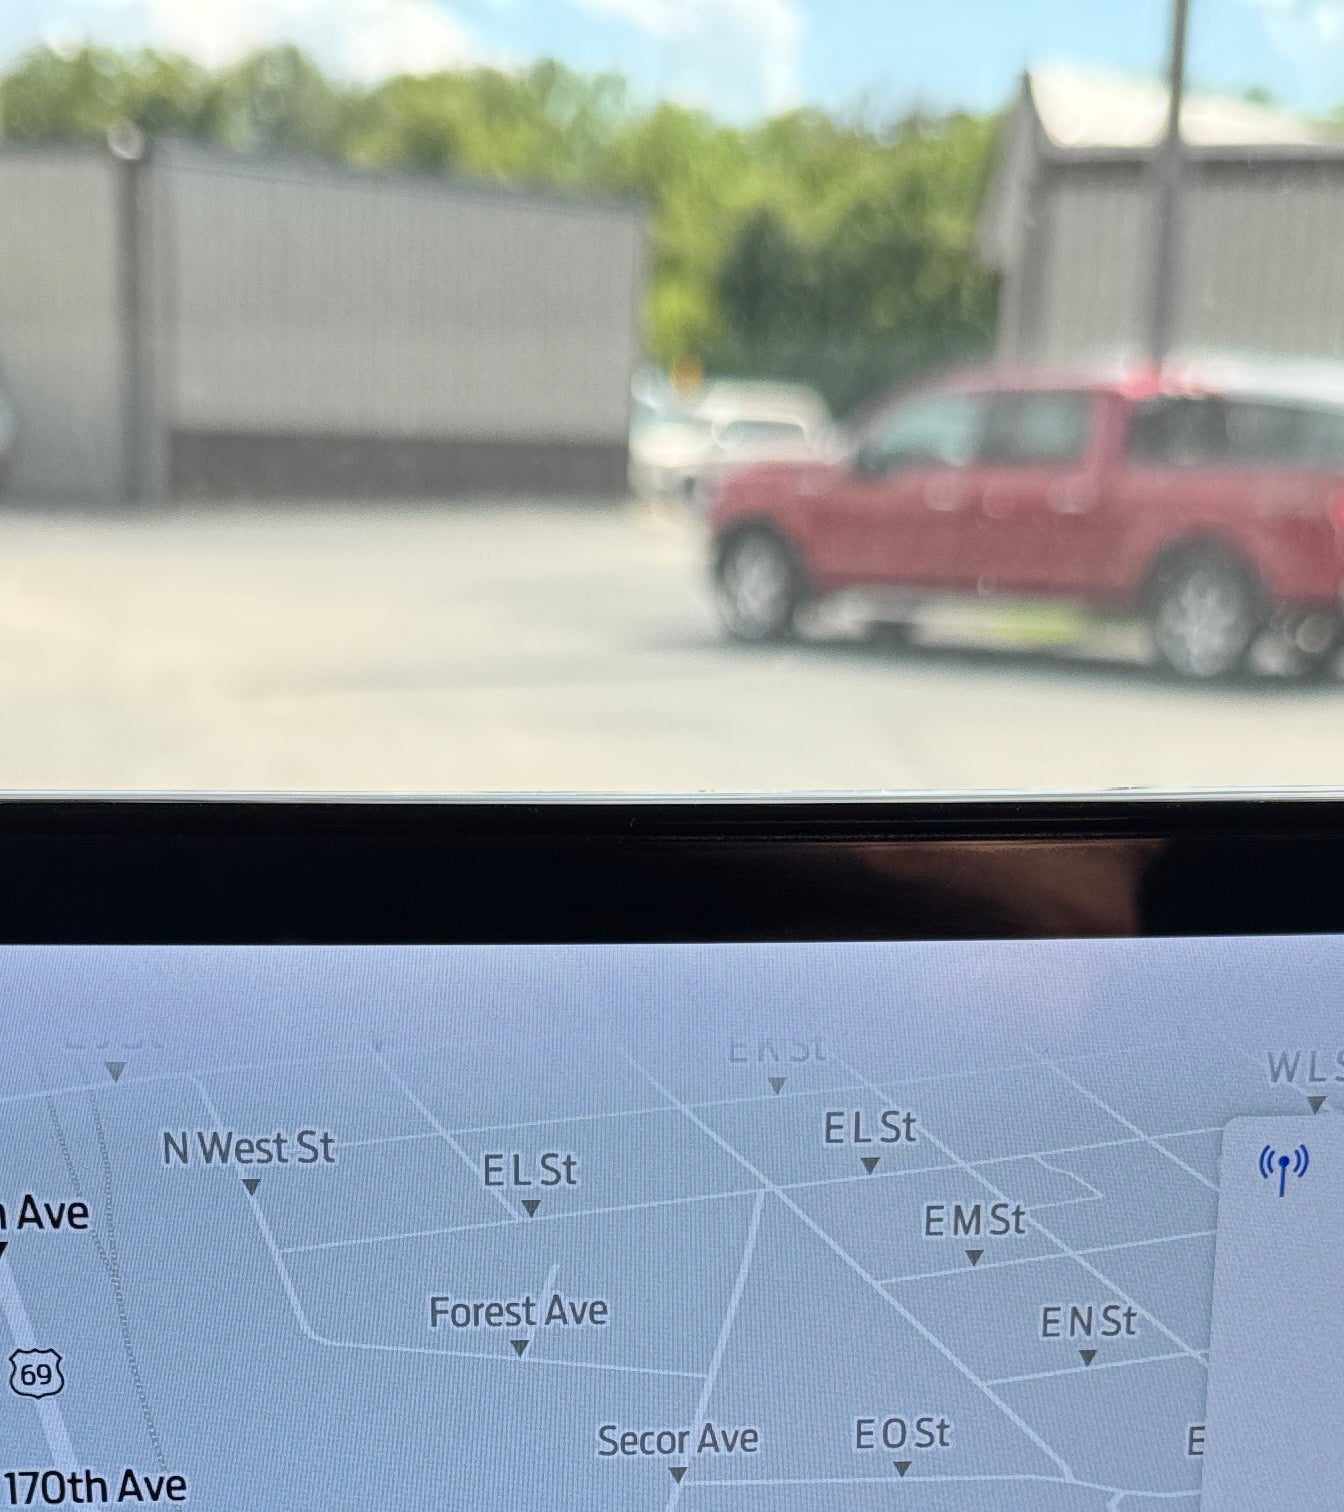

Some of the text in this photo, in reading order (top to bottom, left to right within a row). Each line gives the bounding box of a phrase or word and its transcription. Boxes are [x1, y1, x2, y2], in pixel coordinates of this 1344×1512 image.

[1266, 1050, 1297, 1083] W
[1308, 1051, 1327, 1082] L
[824, 1110, 918, 1144] E L St
[162, 1129, 337, 1165] N West St
[484, 1152, 578, 1186] E L St
[16, 1193, 90, 1231] Ave
[924, 1202, 1027, 1237] E M St
[430, 1294, 609, 1328] Forest Ave
[1041, 1304, 1138, 1339] E N St
[20, 1363, 53, 1387] 69
[598, 1422, 759, 1457] Secor Ave
[855, 1417, 951, 1450] E O St
[1187, 1426, 1205, 1456] E
[4, 1467, 188, 1505] 170th Ave
